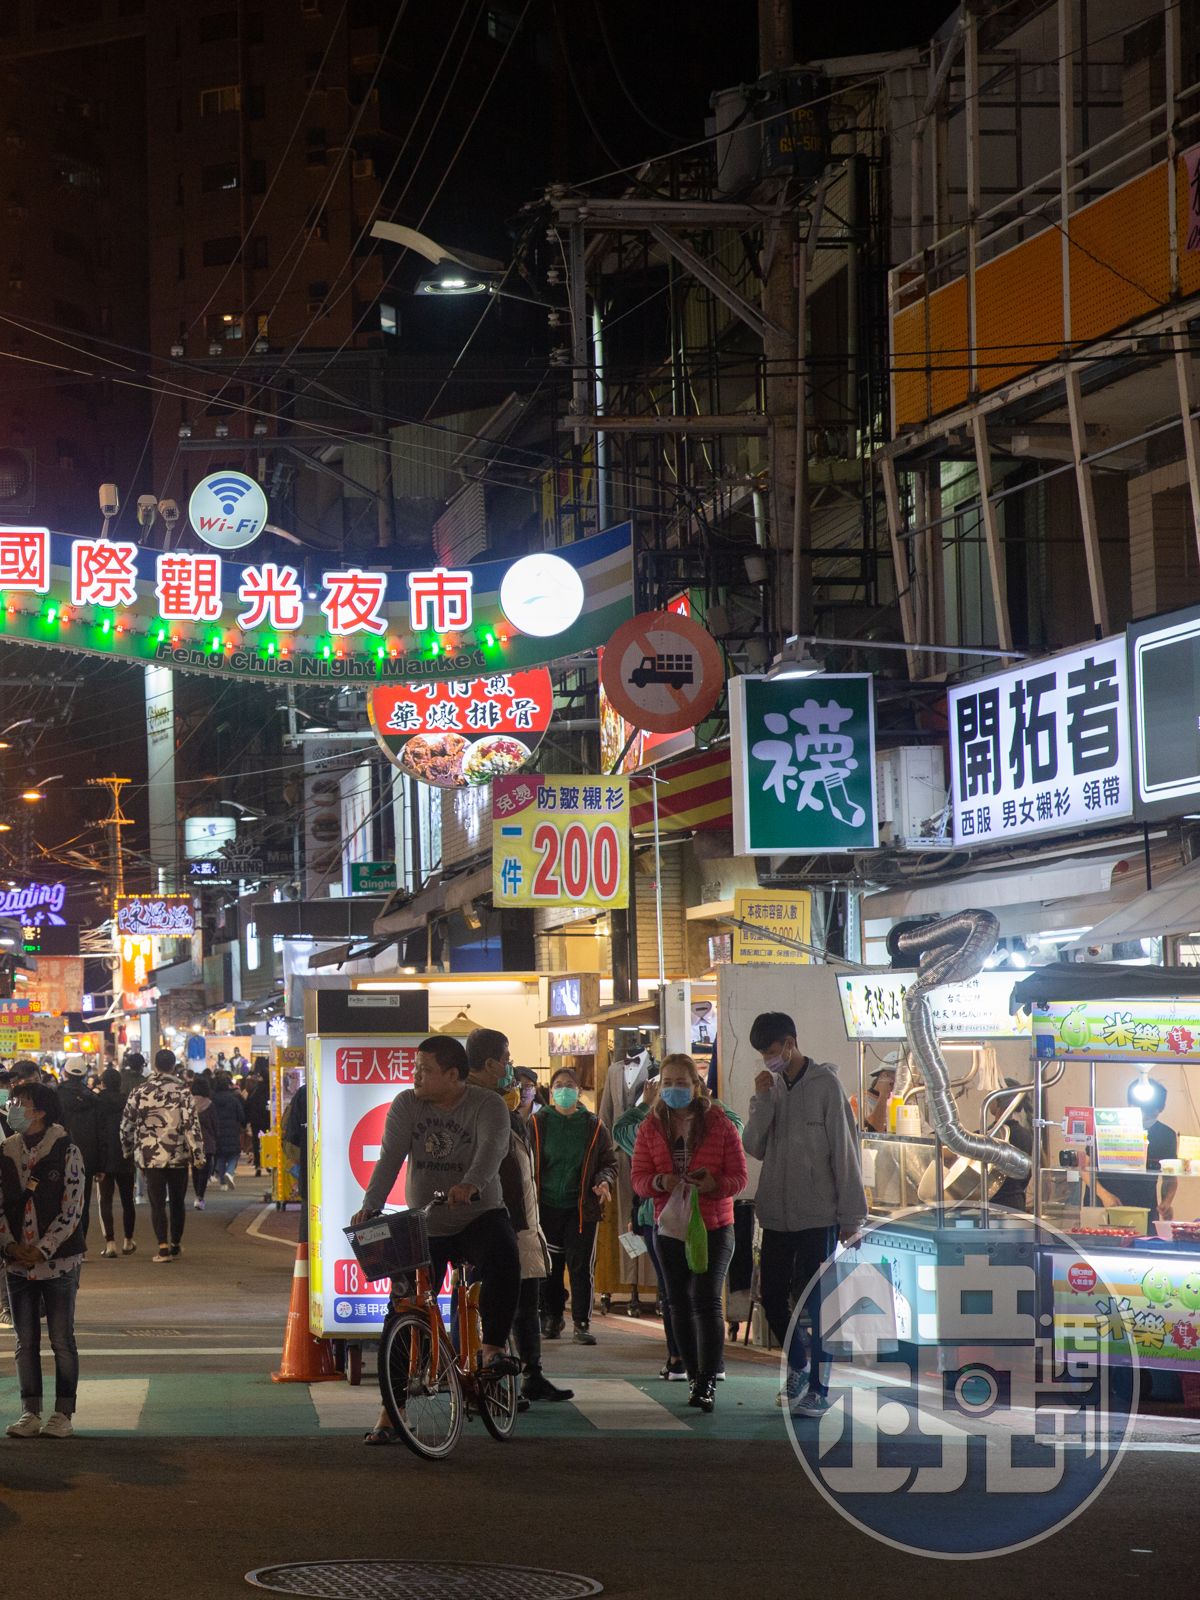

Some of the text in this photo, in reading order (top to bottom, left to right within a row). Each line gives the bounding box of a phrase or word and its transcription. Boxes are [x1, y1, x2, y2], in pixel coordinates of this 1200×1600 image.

[199, 516, 258, 534] Wi-Fi
[156, 642, 486, 678] Feng Chia Night Market
[386, 699, 540, 731] 藥燉排骨
[956, 656, 1120, 802] 開拓者
[751, 698, 867, 829] 襪
[537, 785, 625, 811] 防皺襯衫
[960, 776, 1121, 838] 西服 男女襯衫 領帶
[531, 821, 621, 901] 200
[1102, 1011, 1161, 1053] 米樂
[1094, 1295, 1167, 1350] 米樂
